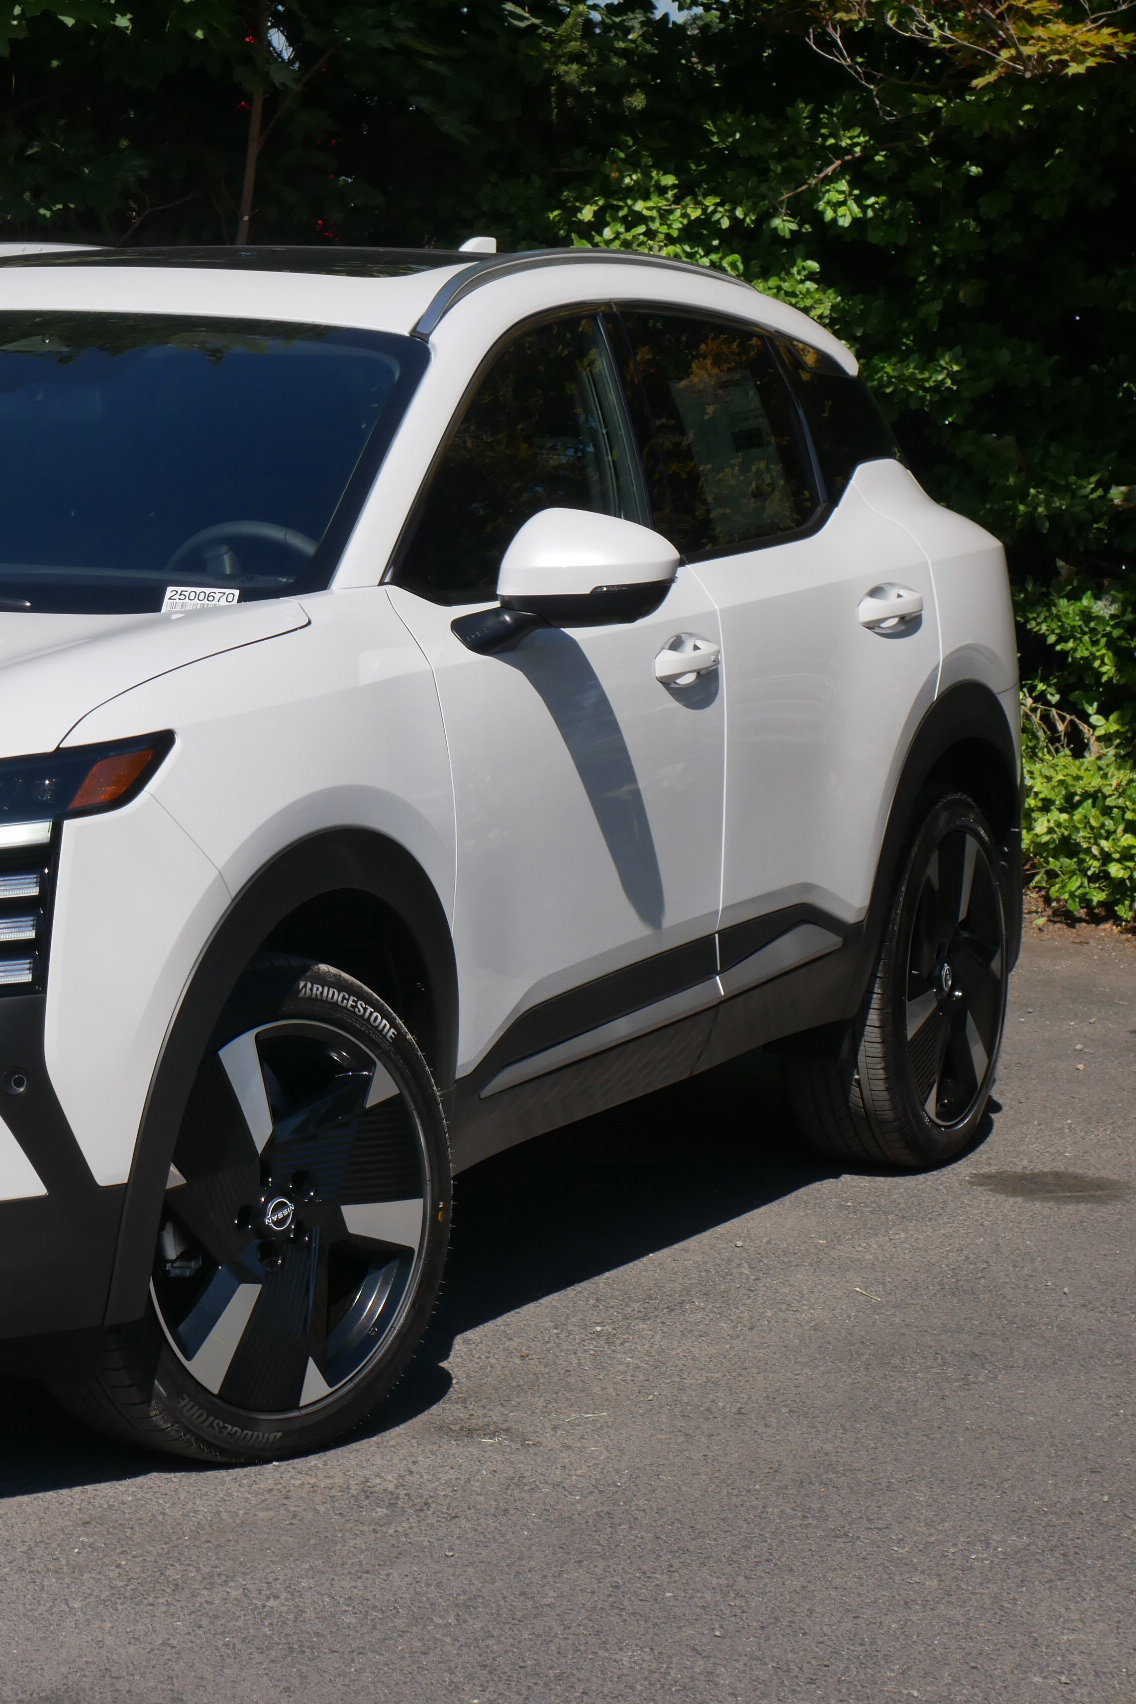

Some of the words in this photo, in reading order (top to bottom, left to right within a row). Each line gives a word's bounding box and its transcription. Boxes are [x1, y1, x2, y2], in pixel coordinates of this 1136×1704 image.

[168, 589, 236, 603] 2500670
[297, 980, 398, 1043] BRIDGESTONE
[265, 1203, 294, 1225] NISSAN
